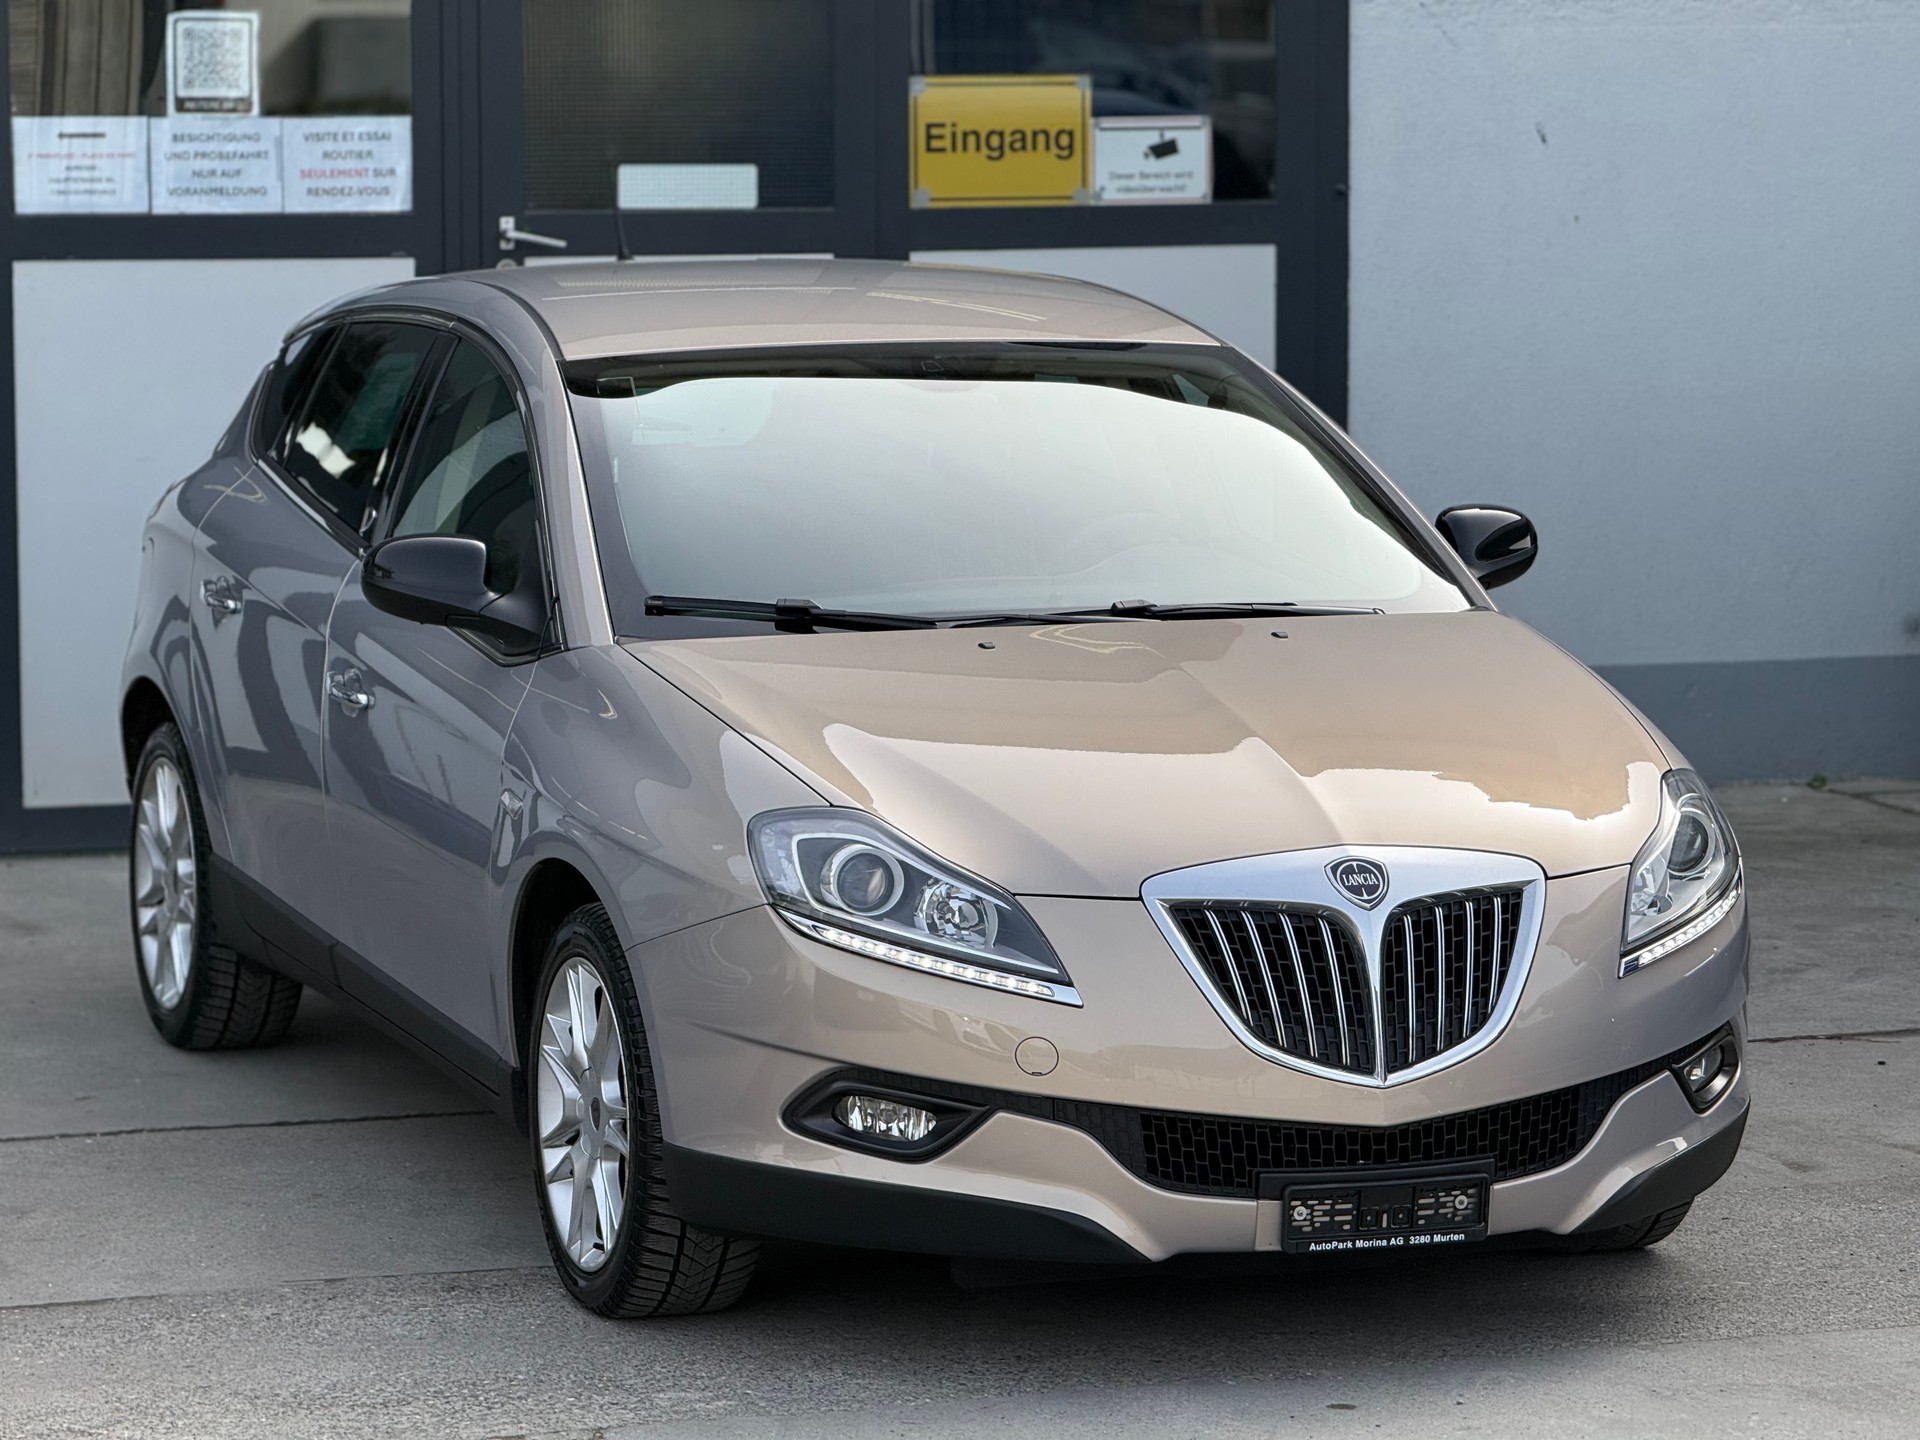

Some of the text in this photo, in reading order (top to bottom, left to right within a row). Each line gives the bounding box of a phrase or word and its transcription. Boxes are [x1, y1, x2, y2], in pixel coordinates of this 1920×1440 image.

[171, 132, 261, 143] BESICHTIGUNG
[303, 131, 391, 141] VISITE ET ESSAI
[925, 122, 1075, 161] Eingang
[164, 150, 269, 160] UND PROBEFAHRT
[322, 150, 373, 160] ROUTIER
[192, 169, 242, 178] NUR AUF
[300, 168, 396, 178] SEULEMENT SUR
[167, 186, 268, 196] VORANMELDUNG
[306, 186, 390, 196] RENDEZ-VOUS
[1341, 873, 1379, 886] LANCIA
[1309, 1233, 1465, 1252] AutoPark Morina AG 3280 Murten
